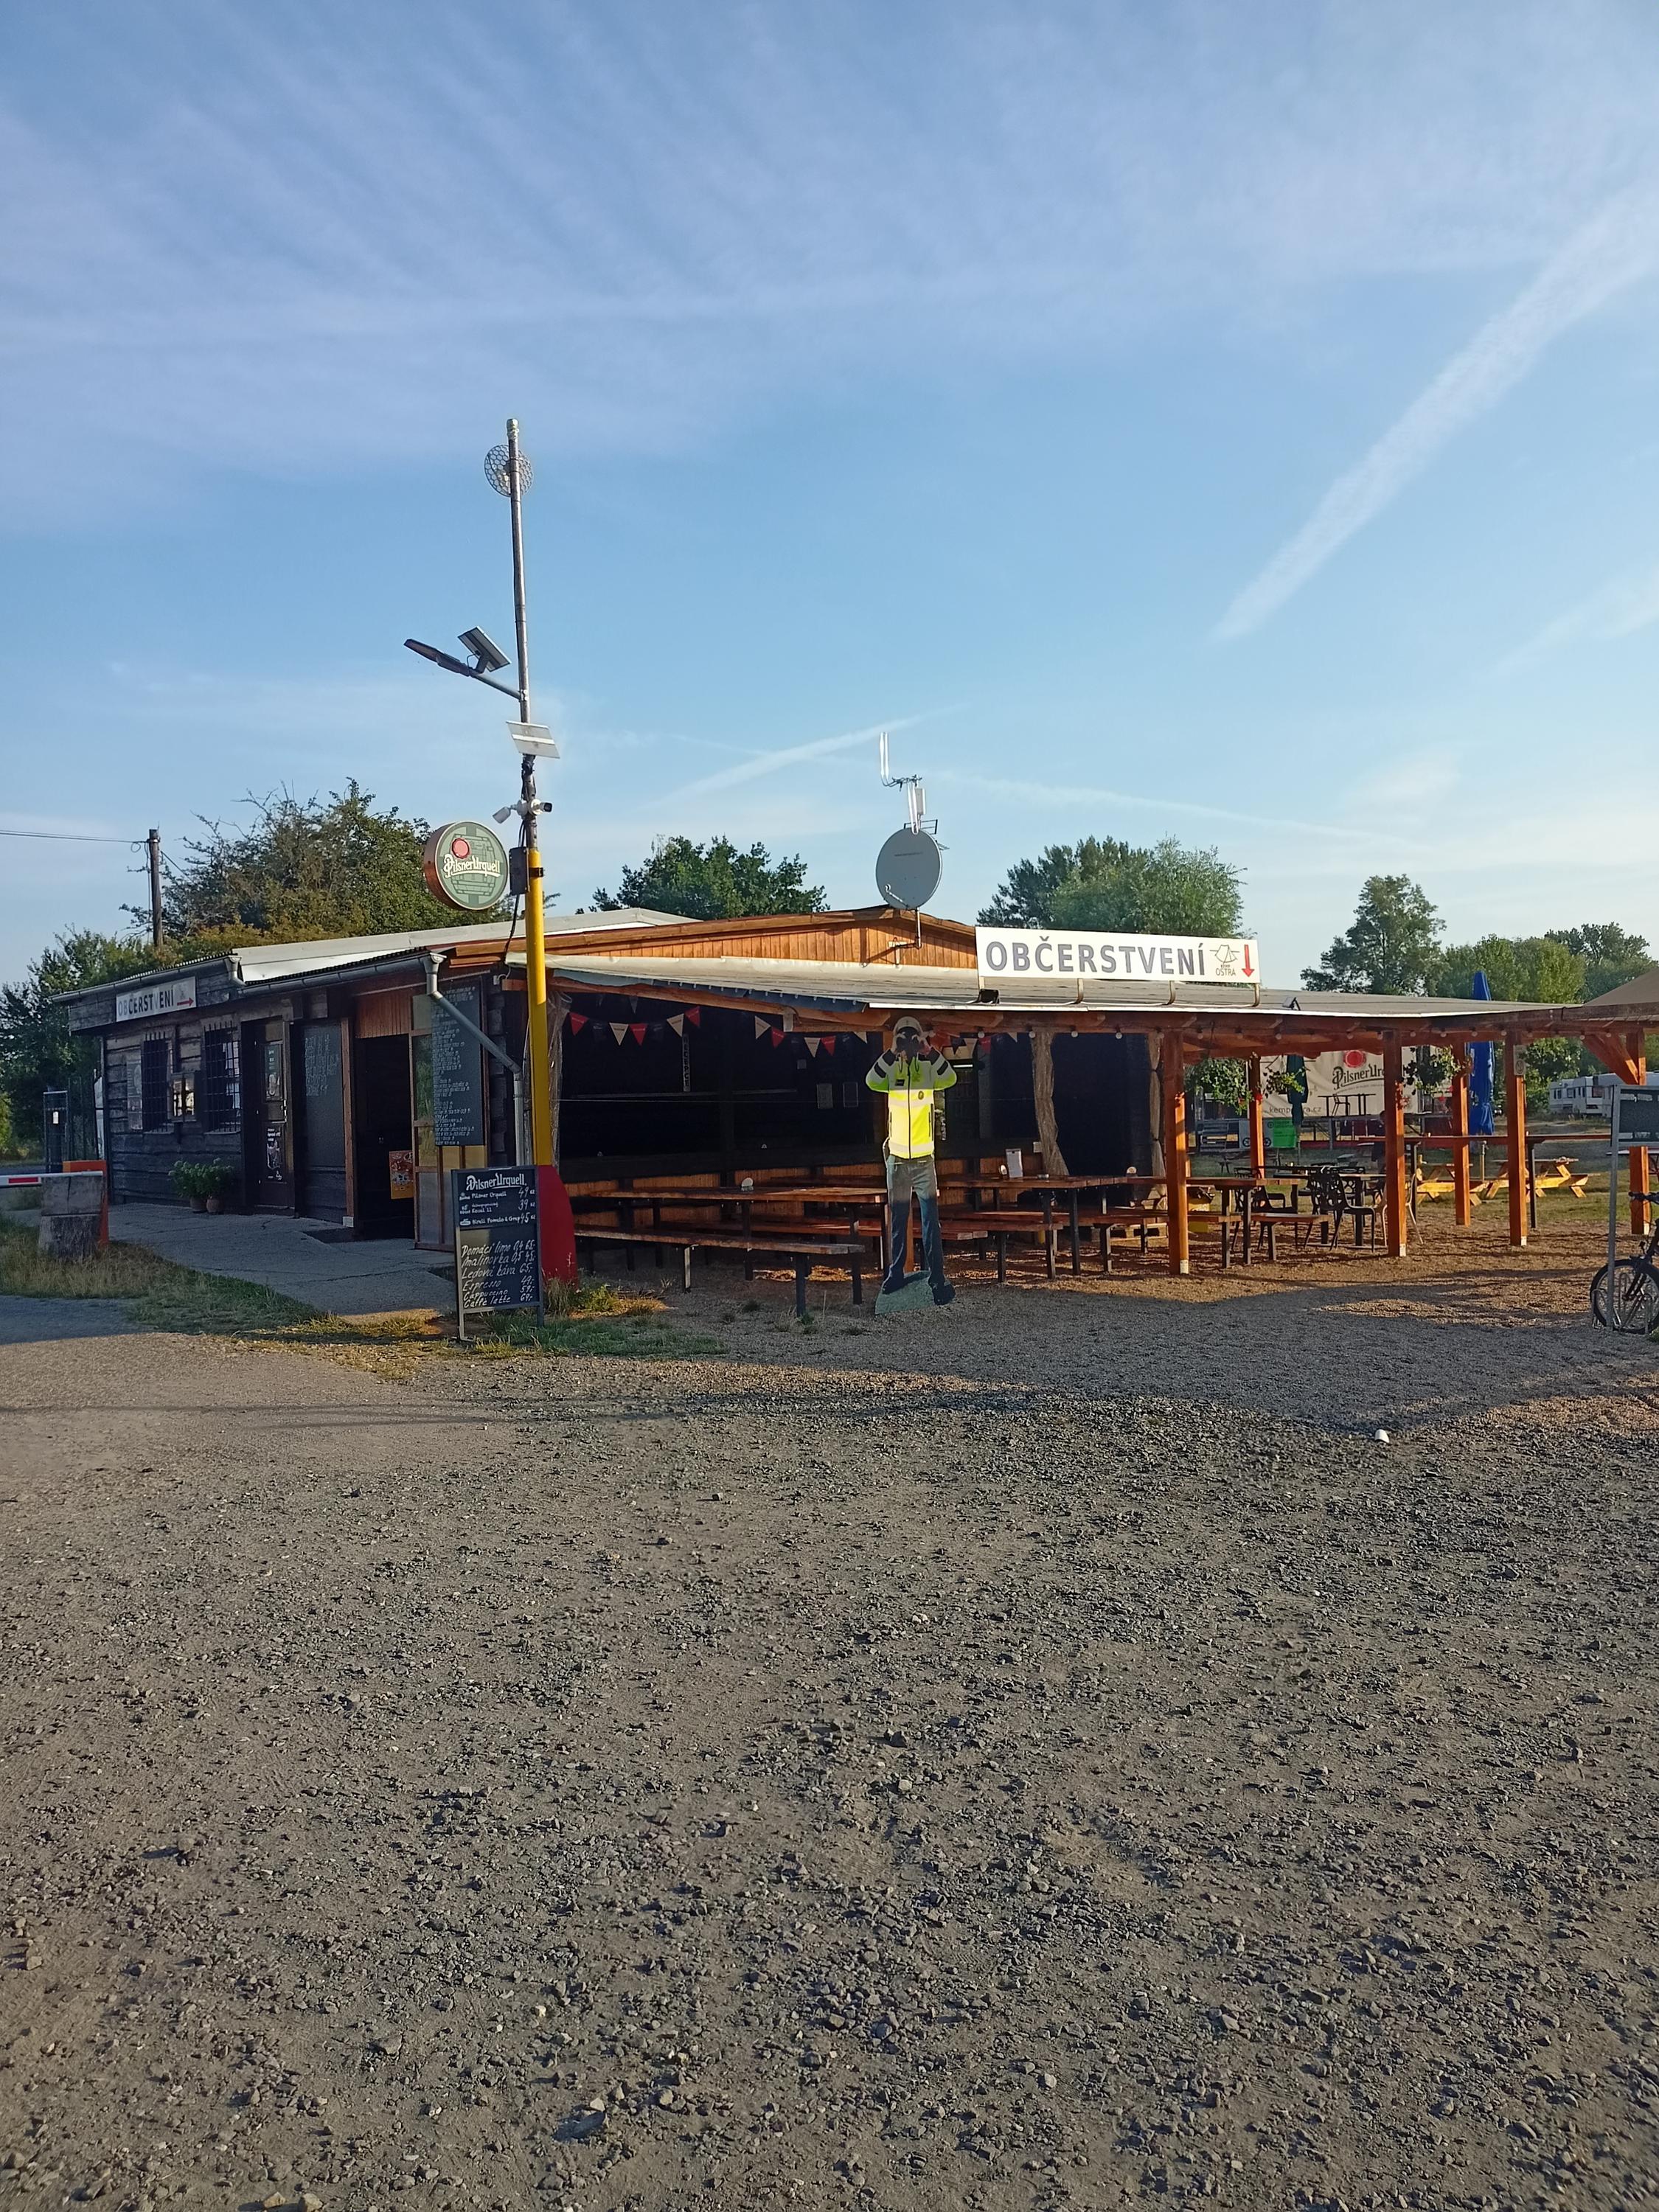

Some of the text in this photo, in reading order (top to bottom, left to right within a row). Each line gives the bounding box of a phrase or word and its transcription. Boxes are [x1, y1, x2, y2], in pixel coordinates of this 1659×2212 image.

[986, 936, 1205, 975] OBČERSTVENÍ
[518, 1186, 529, 1198] 49
[518, 1198, 529, 1211] 39
[520, 1212, 531, 1225] 45
[495, 1241, 512, 1253] limo
[511, 1251, 524, 1265] 0,5
[461, 1265, 495, 1279] Ledová
[462, 1279, 502, 1293] Espresso
[463, 1289, 509, 1301] Cappuccino
[490, 1294, 511, 1305] latte
